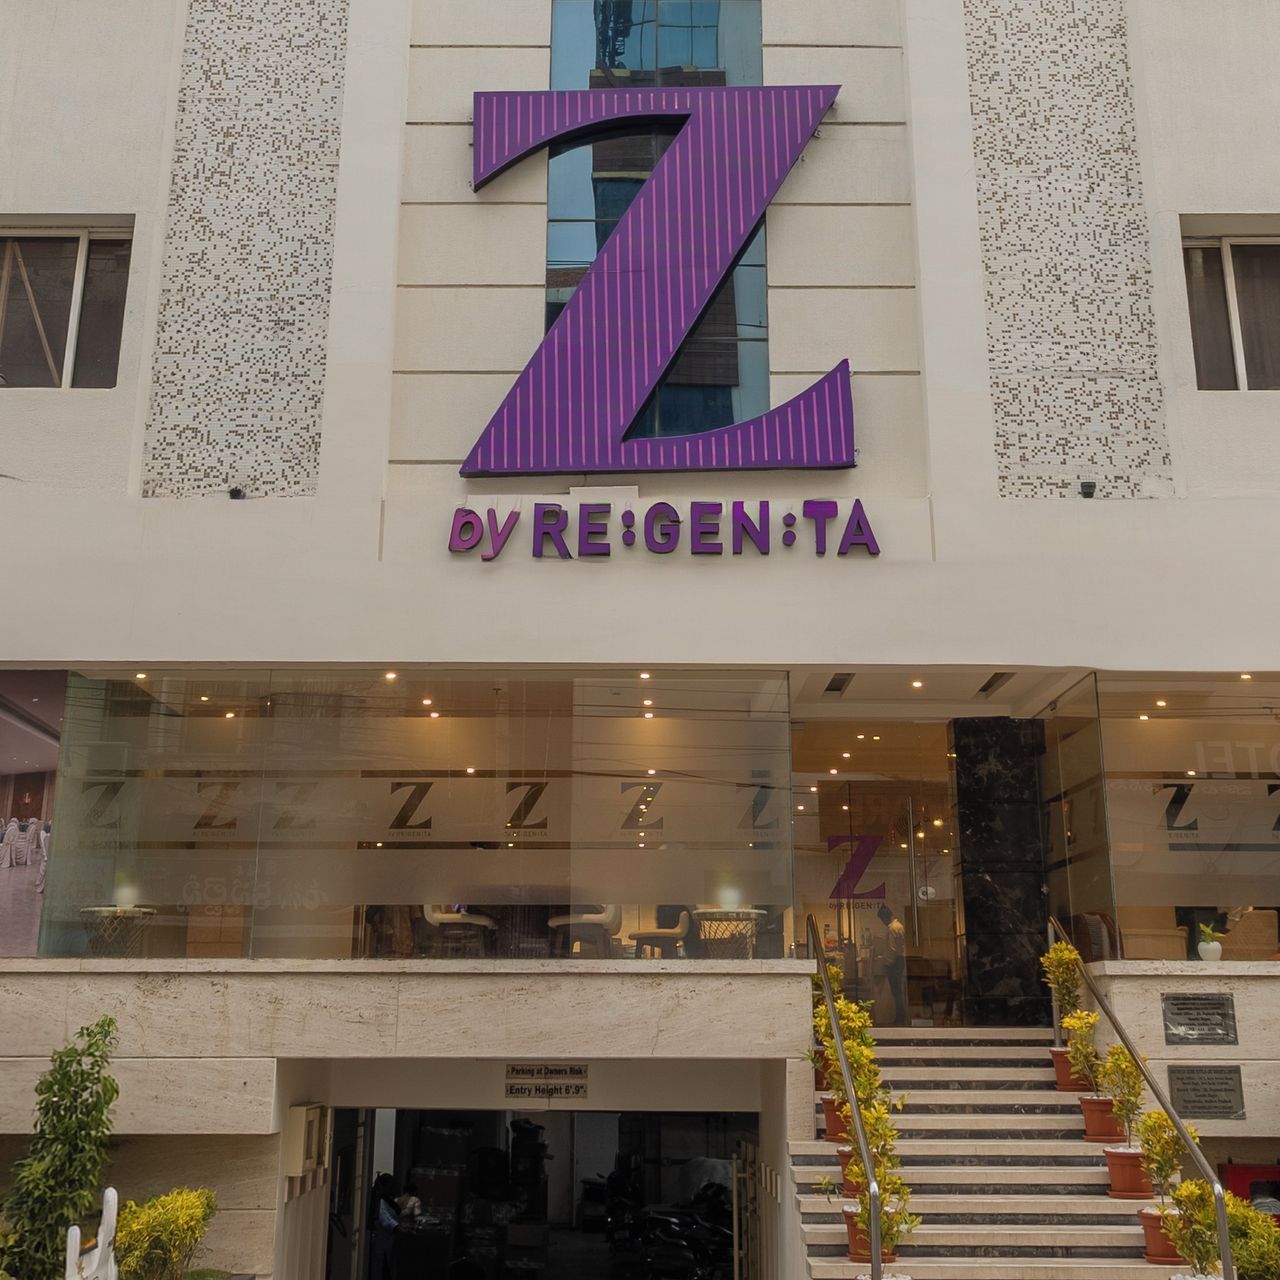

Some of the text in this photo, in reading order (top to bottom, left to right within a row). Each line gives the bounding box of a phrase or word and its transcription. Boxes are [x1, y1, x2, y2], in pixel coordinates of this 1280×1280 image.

[459, 84, 857, 479] Z
[448, 505, 520, 562] by
[388, 781, 434, 830] Z
[505, 781, 549, 830] Z
[620, 782, 664, 830] Z
[827, 835, 886, 899] Z
[509, 1085, 532, 1097] Entry
[534, 1085, 562, 1097] Height
[510, 1066, 535, 1077] Parking
